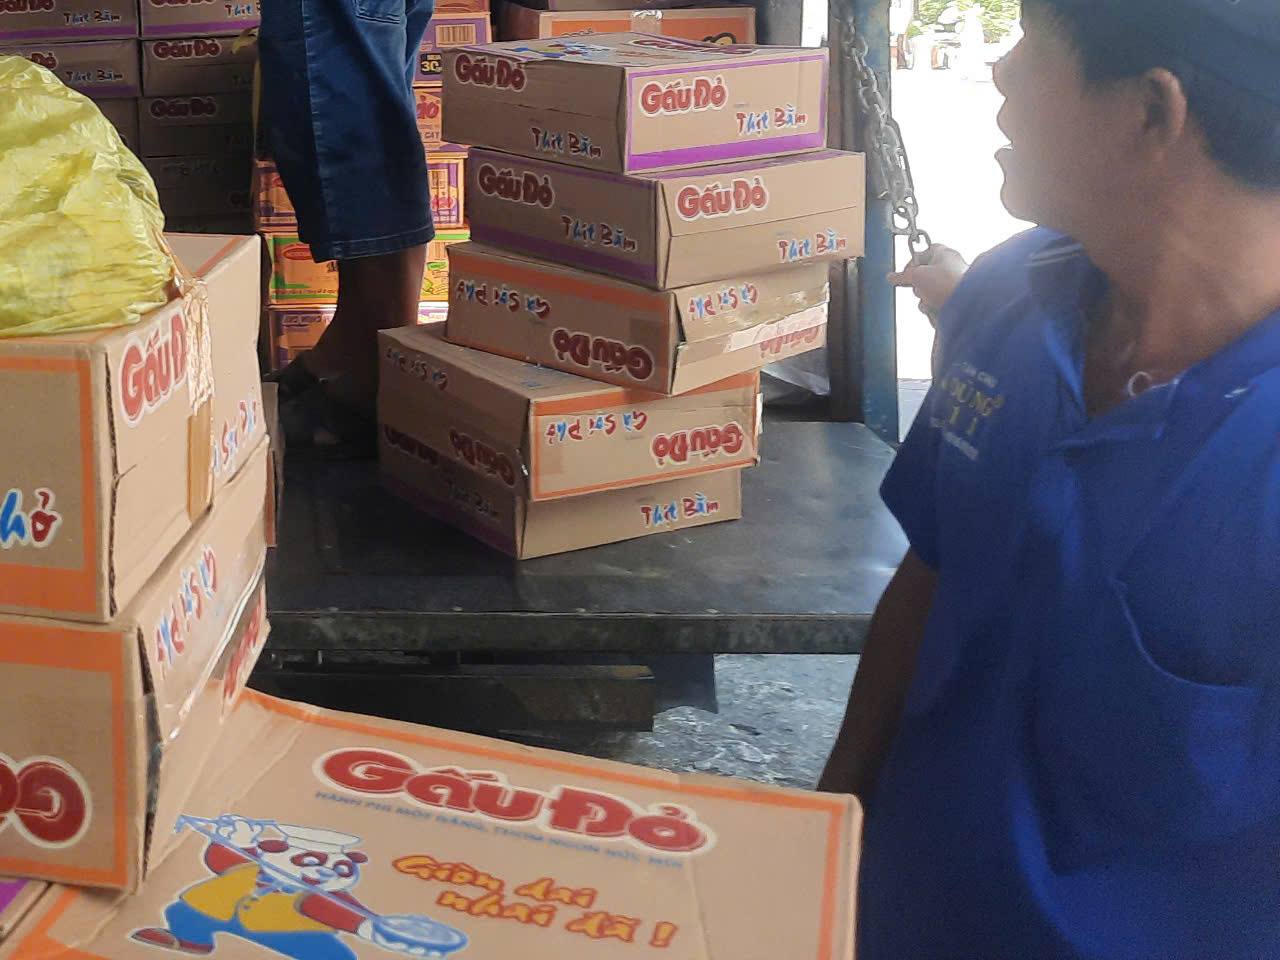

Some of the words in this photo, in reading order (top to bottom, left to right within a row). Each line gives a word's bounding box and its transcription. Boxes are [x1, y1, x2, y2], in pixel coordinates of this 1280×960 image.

[454, 55, 495, 89] Gấu
[496, 57, 526, 91] Đỏ
[640, 81, 693, 114] Gấu
[693, 76, 728, 109] Đỏ
[735, 109, 770, 137] Thịt
[773, 104, 808, 128] Bằm
[532, 127, 564, 155] Thịt
[567, 132, 604, 160] Bằm
[478, 164, 522, 200] Gấu
[522, 176, 555, 209] Đỏ
[677, 184, 732, 219] Gấu
[732, 177, 769, 212] Đỏ
[562, 216, 597, 245] Thịt
[599, 222, 638, 253] Bằm
[777, 239, 811, 263] Thịt
[815, 229, 847, 257] Bằm
[121, 330, 170, 420] Gấu
[170, 313, 188, 381] Đ
[552, 327, 597, 369] Đỏ
[597, 336, 653, 379] Gấu
[652, 432, 690, 466] Đỏ
[687, 422, 745, 456] Gấu
[640, 504, 678, 527] Thịt
[682, 492, 720, 518] Bằm
[319, 748, 545, 825] Gấu
[545, 785, 710, 853] Đỏ
[392, 853, 505, 893] Giòn
[514, 877, 598, 909] dai
[435, 889, 557, 928] nhai
[564, 910, 641, 942] đã
